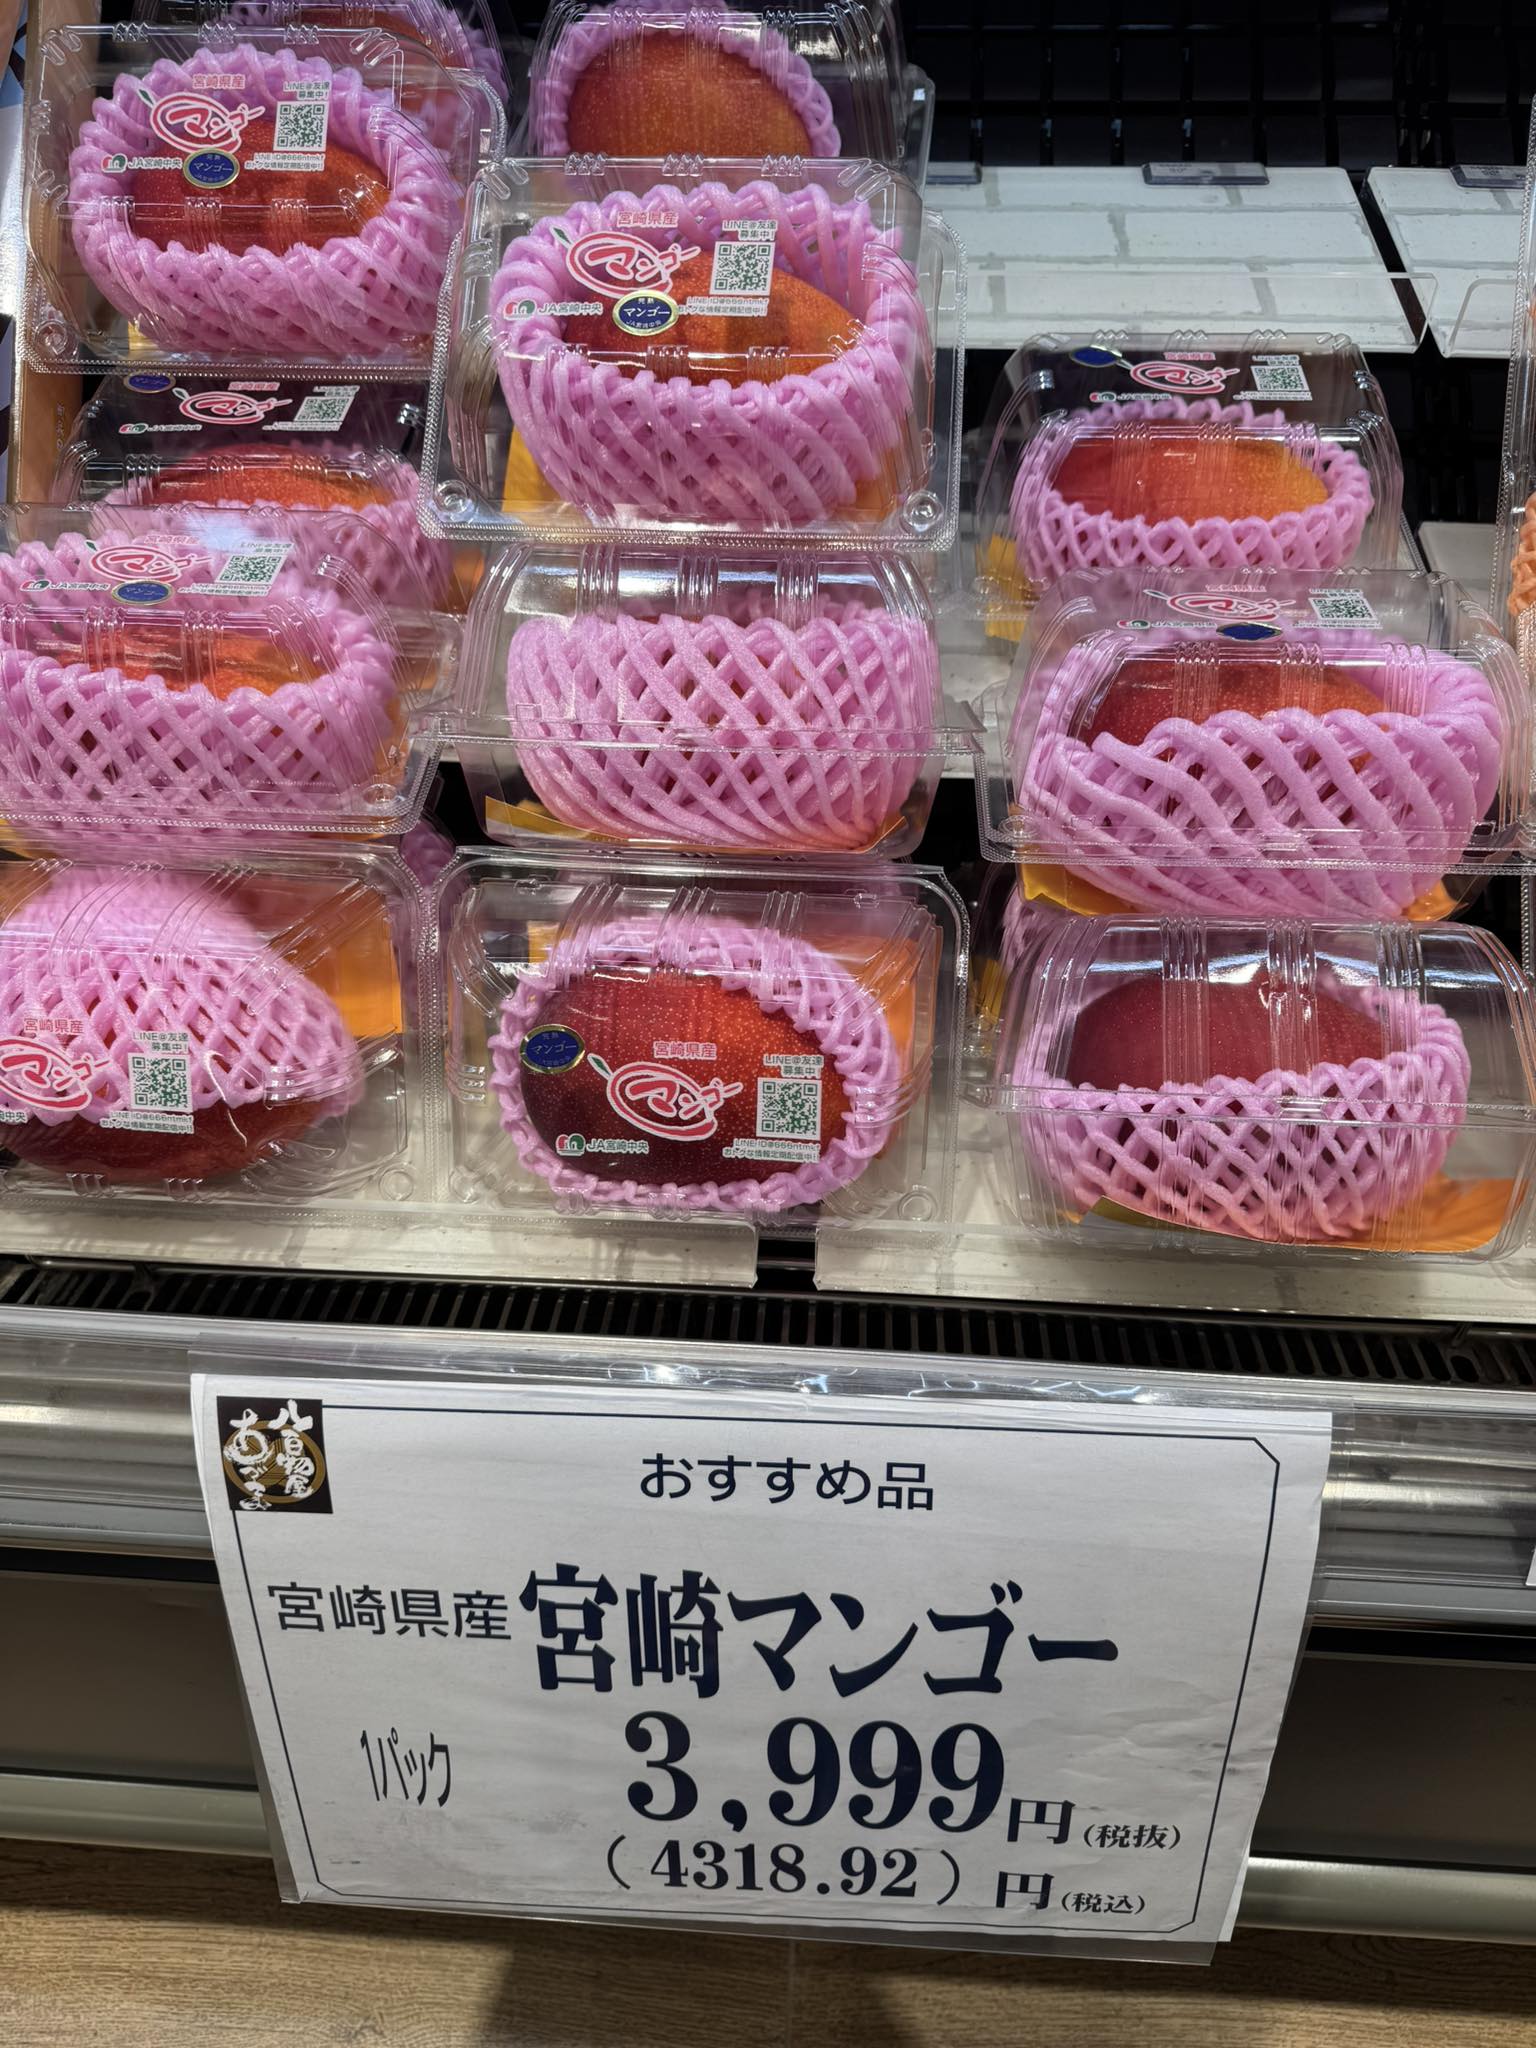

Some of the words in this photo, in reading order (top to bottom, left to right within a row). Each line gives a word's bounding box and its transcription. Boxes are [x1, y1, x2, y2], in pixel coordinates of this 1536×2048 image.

[192, 74, 245, 89] 宮崎県産
[128, 157, 182, 169] JA宮崎中央
[194, 162, 233, 172] マンゴー
[617, 211, 679, 226] 宮崎県産
[723, 220, 777, 230] LINE@友達
[538, 303, 602, 315] JA宮崎中央
[623, 306, 670, 318] マンゴー
[24, 1018, 85, 1034] 宮崎県産
[133, 1032, 189, 1042] LINE@友達
[151, 1042, 188, 1052] 募集中!
[531, 1041, 577, 1055] マンゴー
[653, 1041, 717, 1059] 宮崎県産
[765, 1055, 823, 1066] LINE@友達
[587, 1139, 649, 1153] JA宮崎中央
[641, 1453, 934, 1511] おすすめ品
[268, 1582, 512, 1641] 宮崎県産
[518, 1562, 1119, 1699] 宮崎マンゴー
[360, 1727, 452, 1807] 1パック
